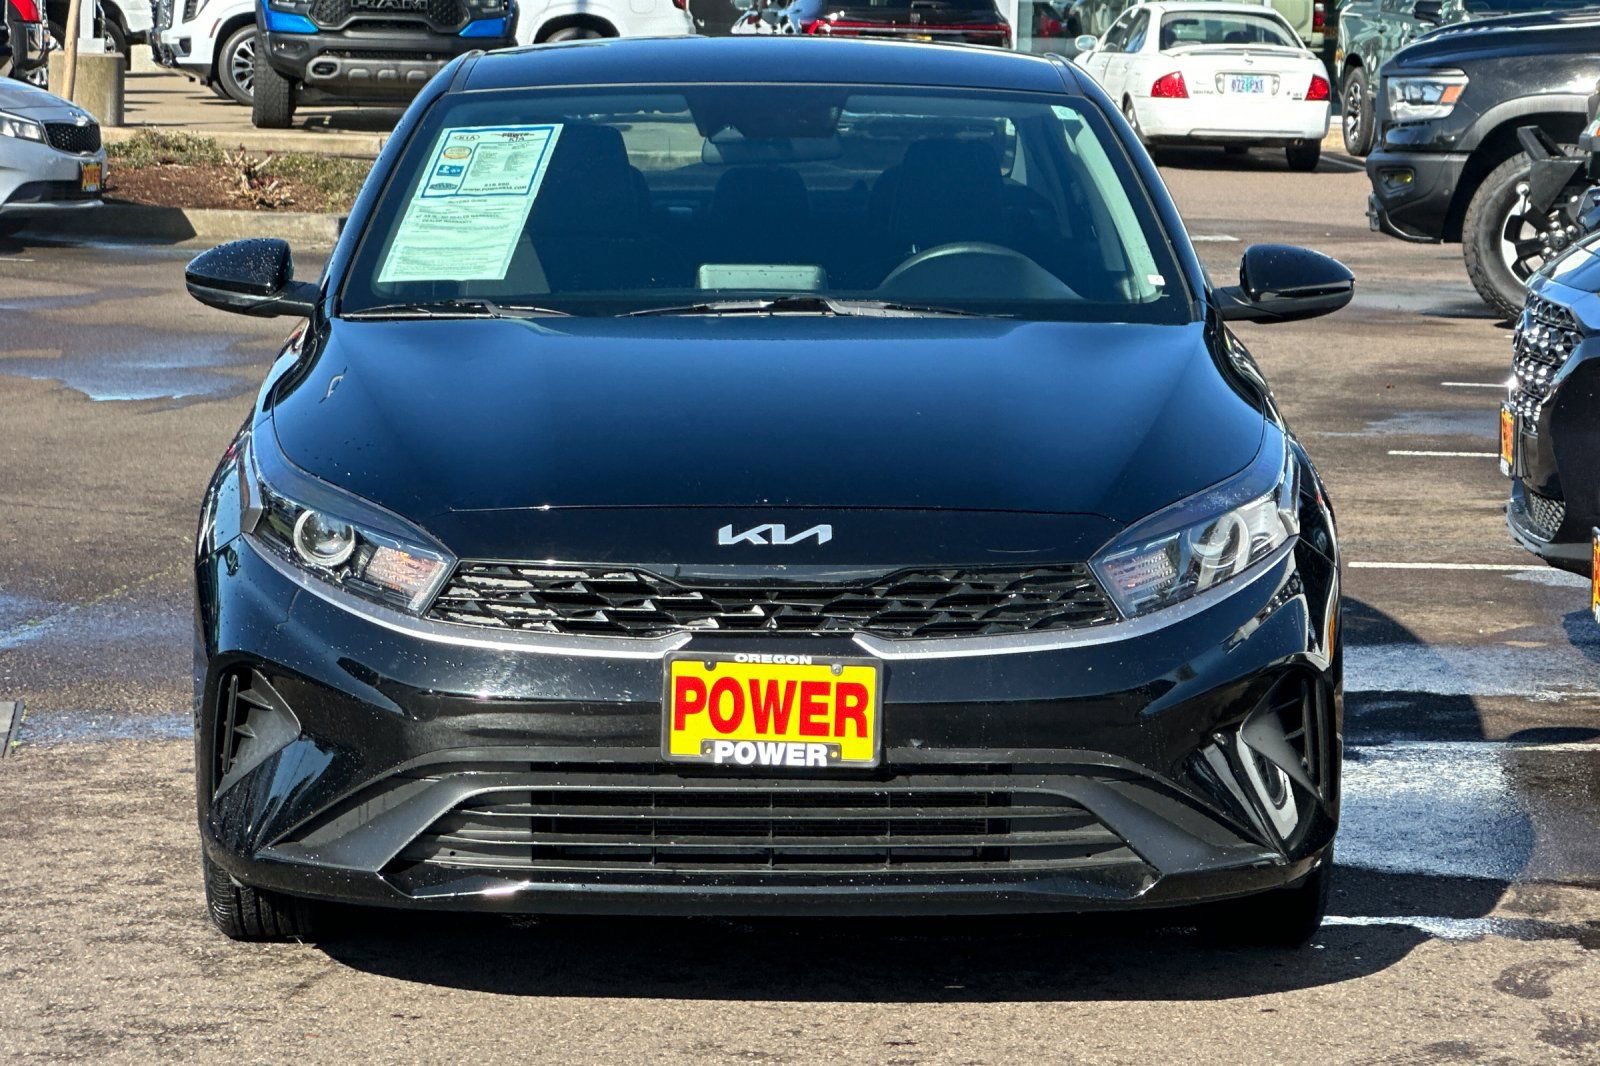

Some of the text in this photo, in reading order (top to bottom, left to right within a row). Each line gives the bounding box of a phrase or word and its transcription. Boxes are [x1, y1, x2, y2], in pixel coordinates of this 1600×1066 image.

[718, 523, 833, 545] KIA
[734, 652, 813, 665] OREGON
[673, 675, 869, 738] POWER
[713, 740, 828, 767] POWER
